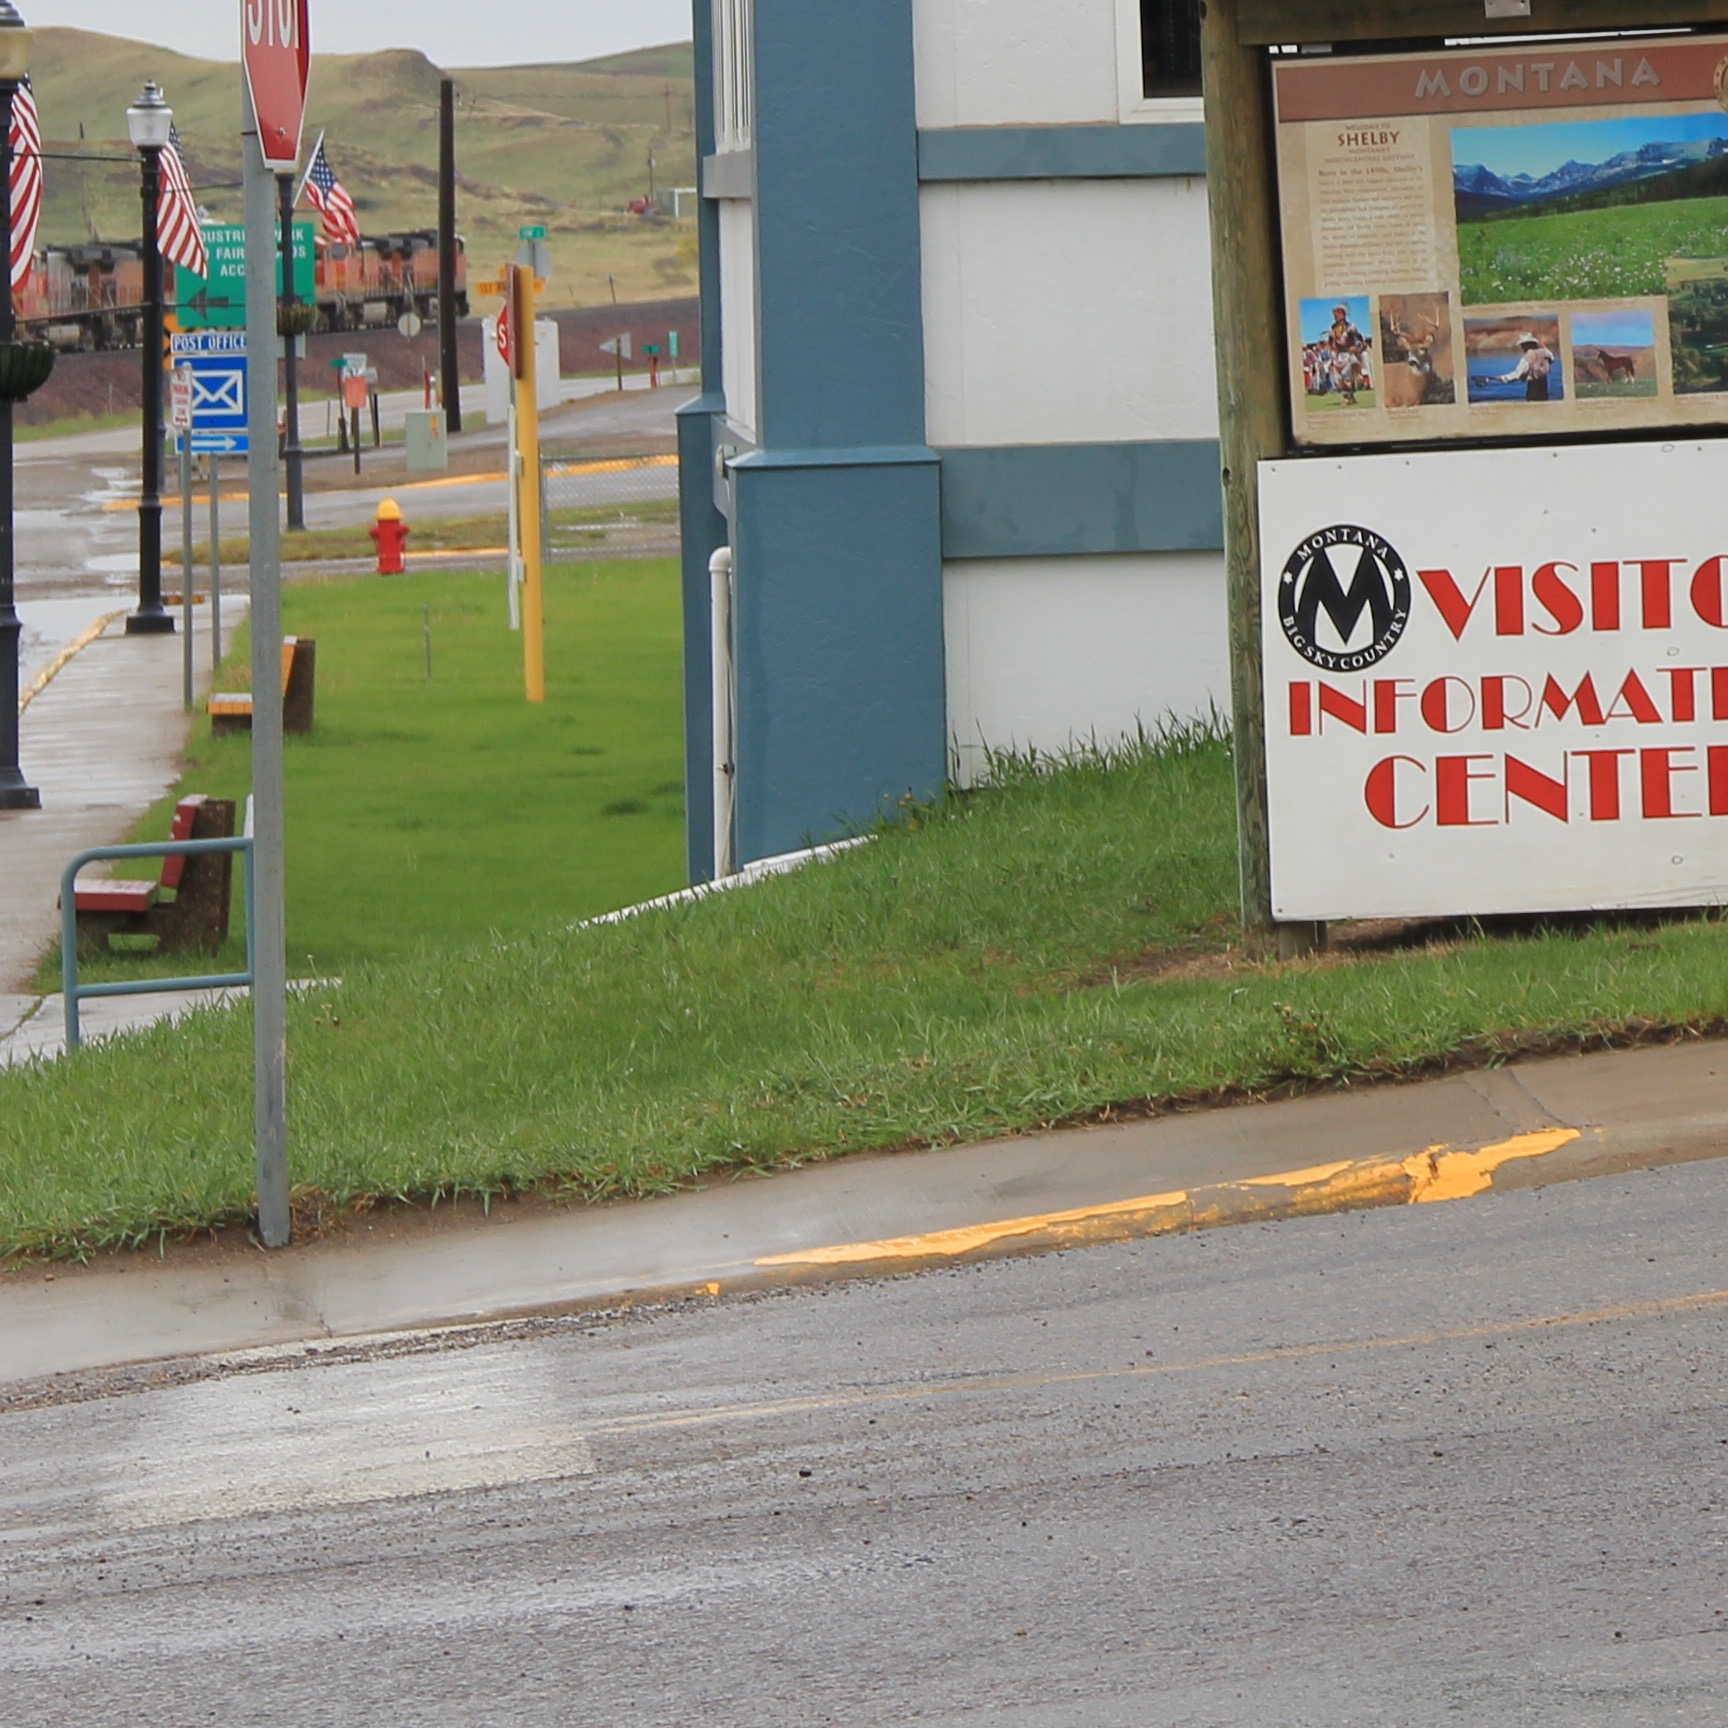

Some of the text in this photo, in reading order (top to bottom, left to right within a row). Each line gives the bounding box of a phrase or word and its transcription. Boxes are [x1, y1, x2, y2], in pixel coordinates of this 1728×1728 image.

[1414, 57, 1661, 99] MONTANA
[1337, 131, 1400, 147] SHELBY
[174, 334, 246, 351] POST OFFICE
[1296, 527, 1389, 562] MONTANA
[1283, 608, 1407, 670] BIG SKY COUNTRY
